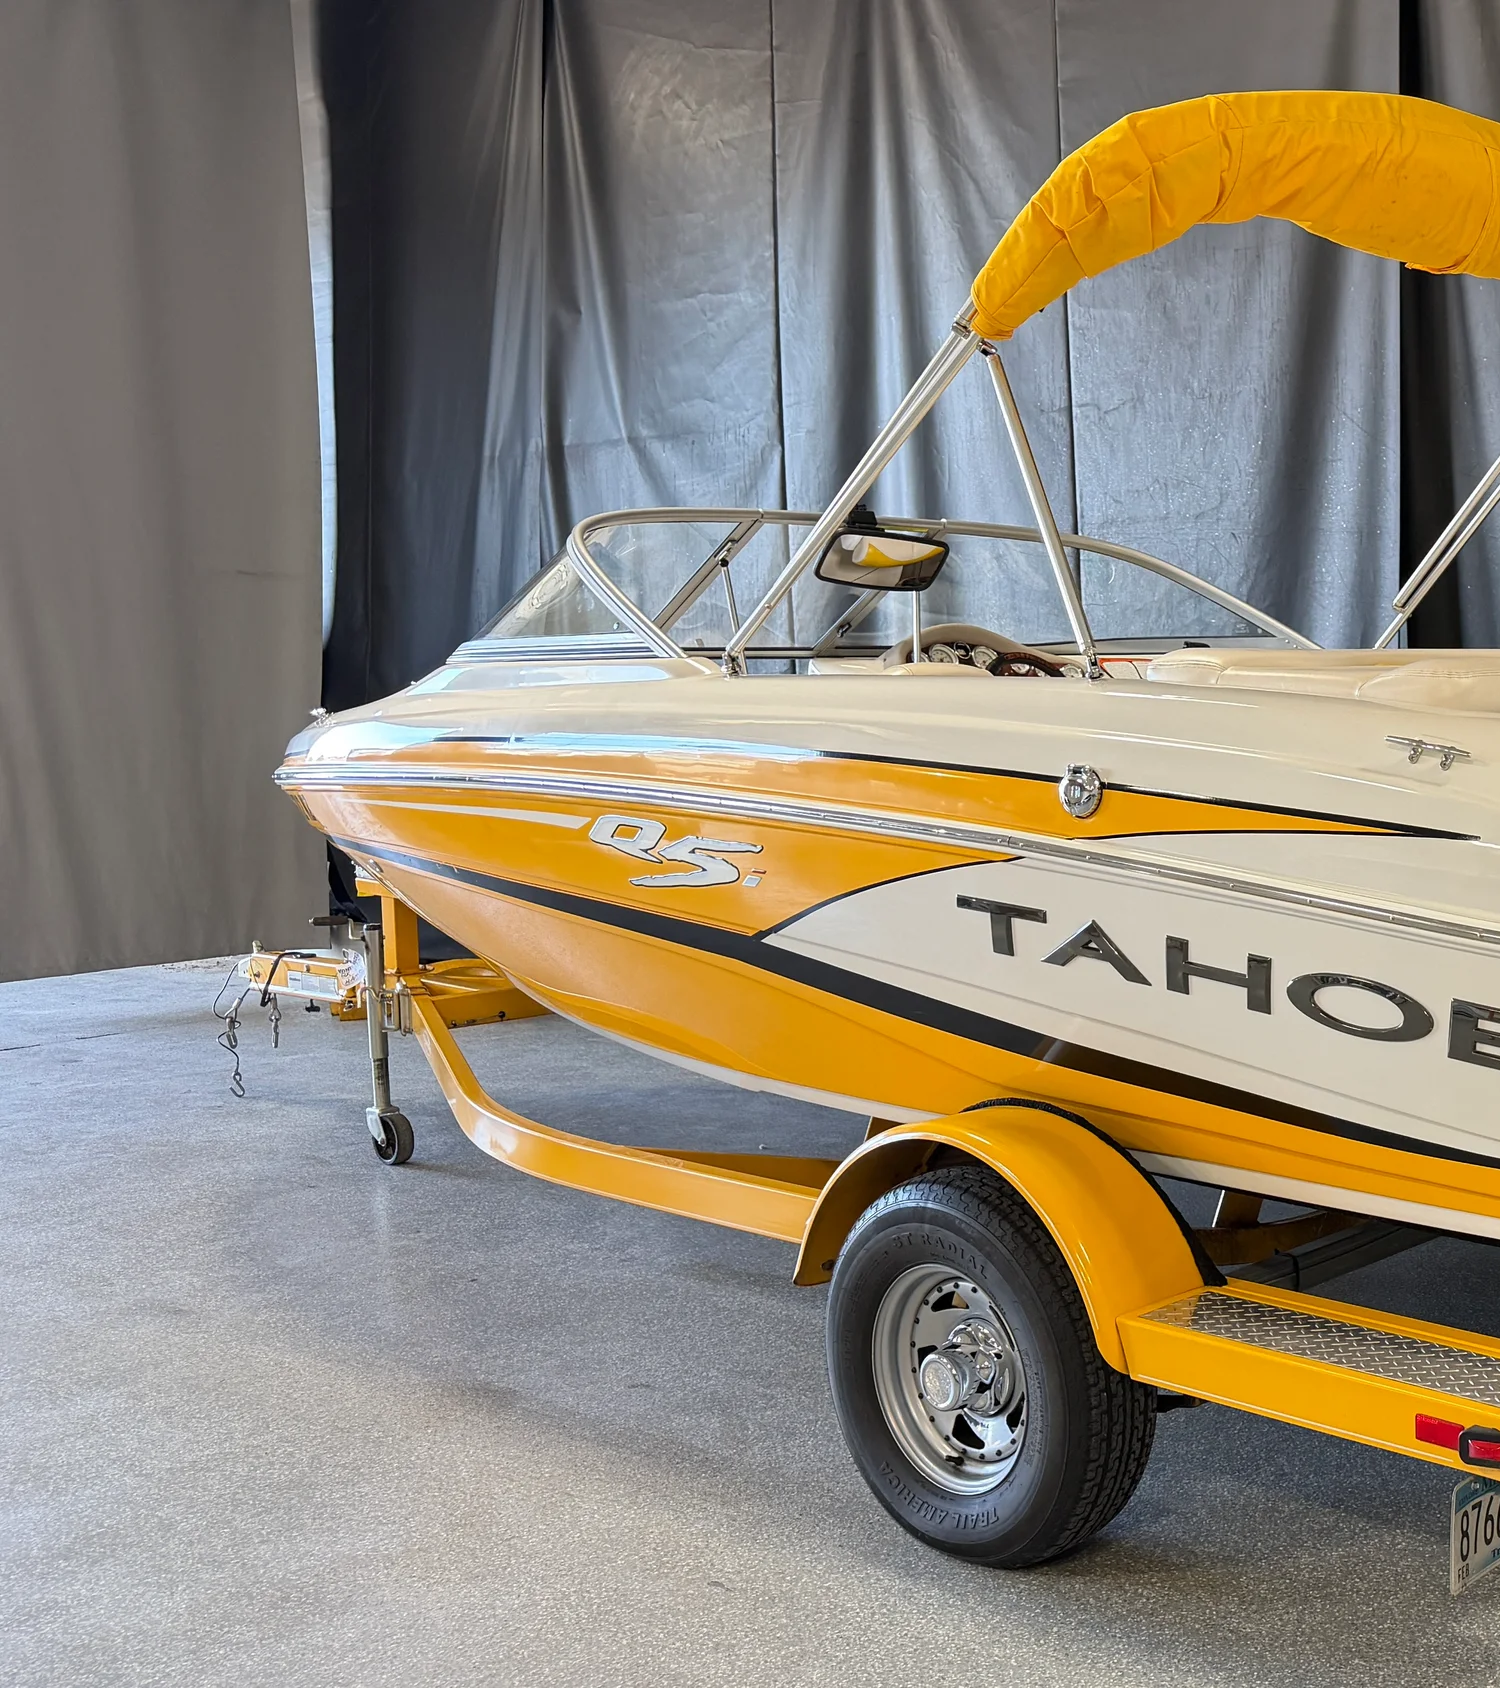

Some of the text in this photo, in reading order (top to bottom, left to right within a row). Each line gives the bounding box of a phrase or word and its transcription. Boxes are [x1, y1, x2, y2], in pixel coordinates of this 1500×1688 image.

[921, 1232, 988, 1280] RADIAL
[879, 1460, 949, 1525] AMERICA
[951, 1506, 1000, 1530] TRAIL
[1457, 1562, 1470, 1583] FEB
